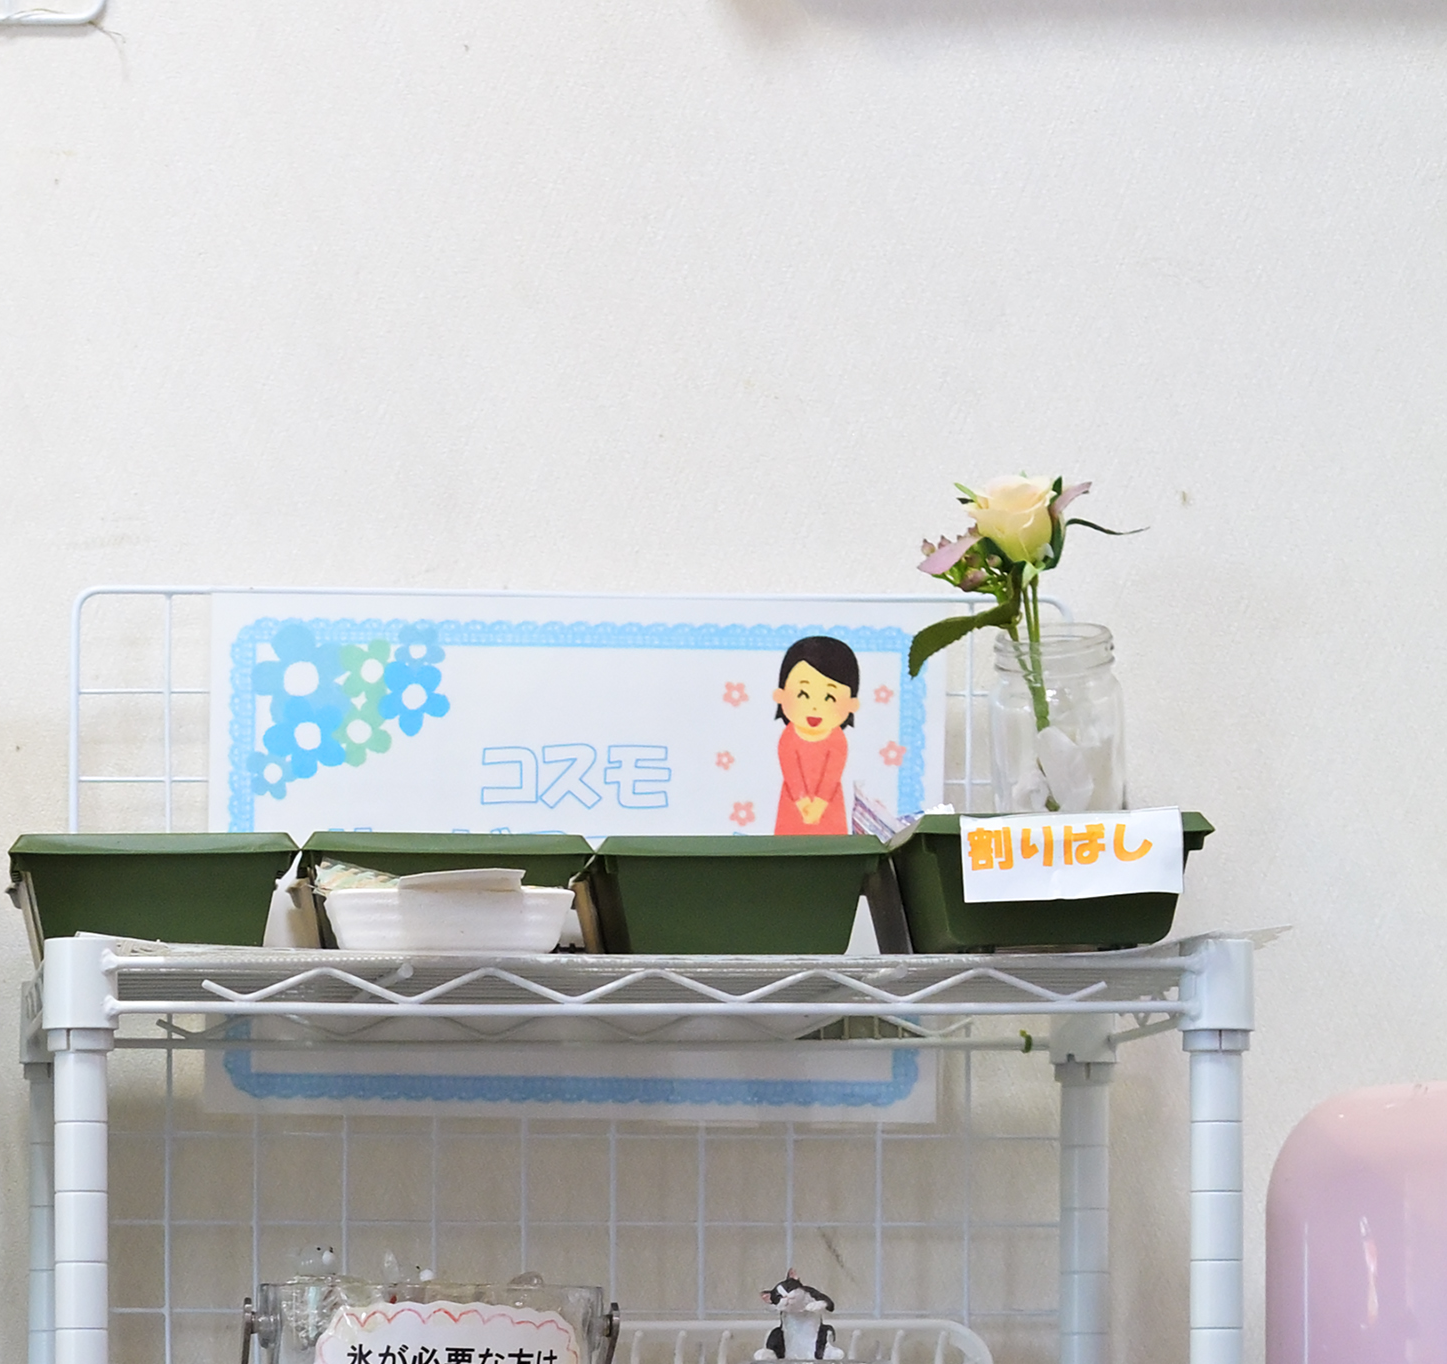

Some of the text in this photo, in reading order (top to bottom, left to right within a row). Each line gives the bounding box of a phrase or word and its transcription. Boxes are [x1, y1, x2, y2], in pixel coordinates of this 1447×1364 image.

[480, 743, 672, 809] コスモ
[966, 822, 1153, 871] 割りばし
